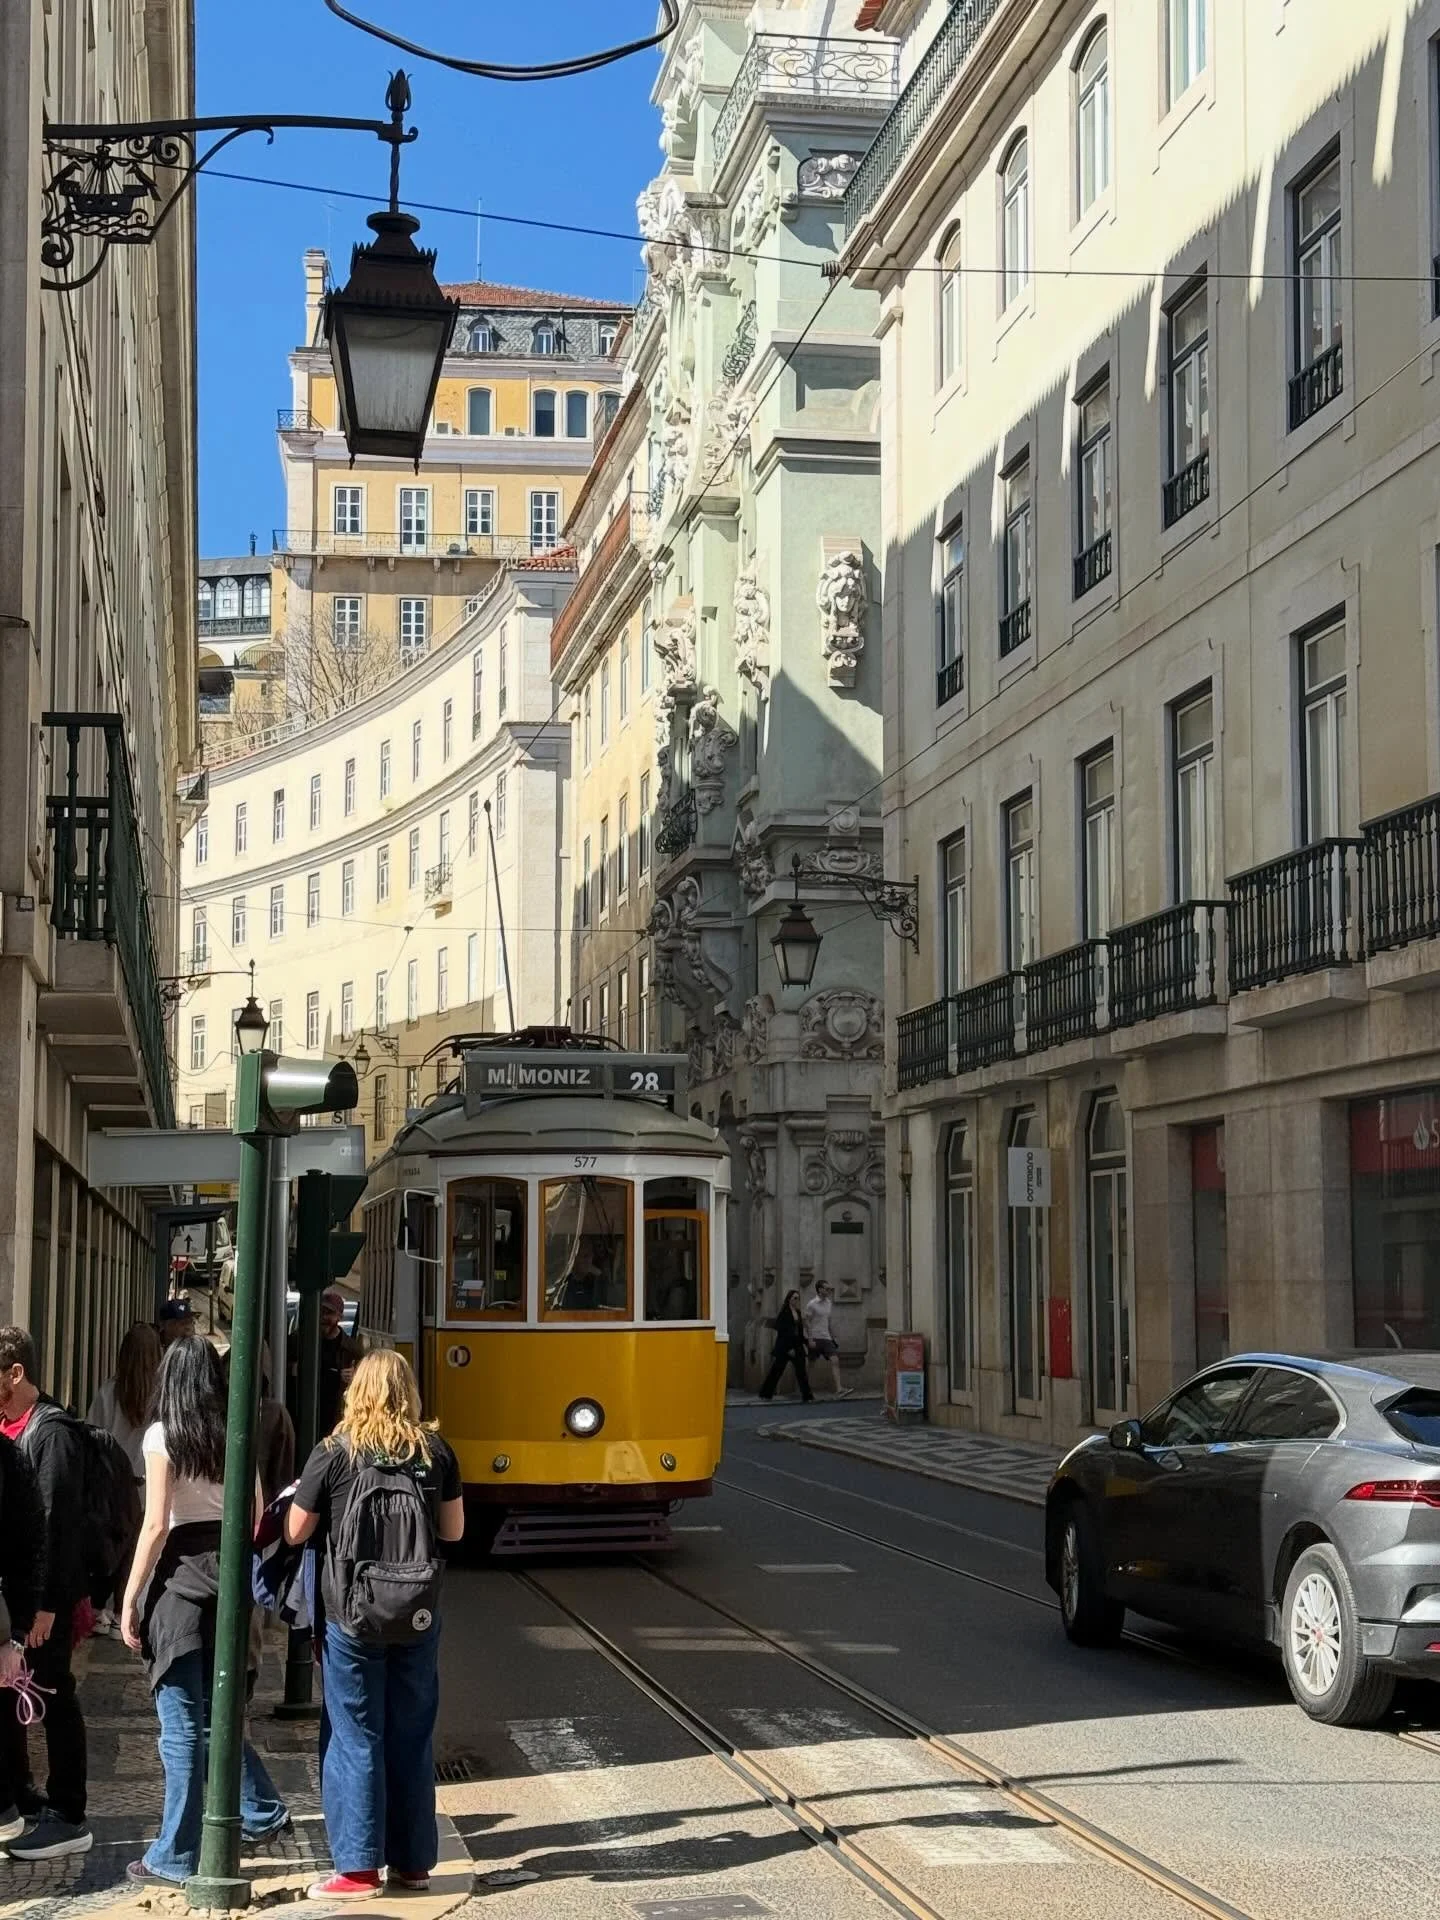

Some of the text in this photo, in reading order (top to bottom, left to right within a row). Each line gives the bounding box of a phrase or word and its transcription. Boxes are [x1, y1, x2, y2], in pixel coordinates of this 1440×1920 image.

[518, 1068, 591, 1085] MONIZ
[629, 1071, 659, 1090] 28
[573, 1156, 597, 1168] 577
